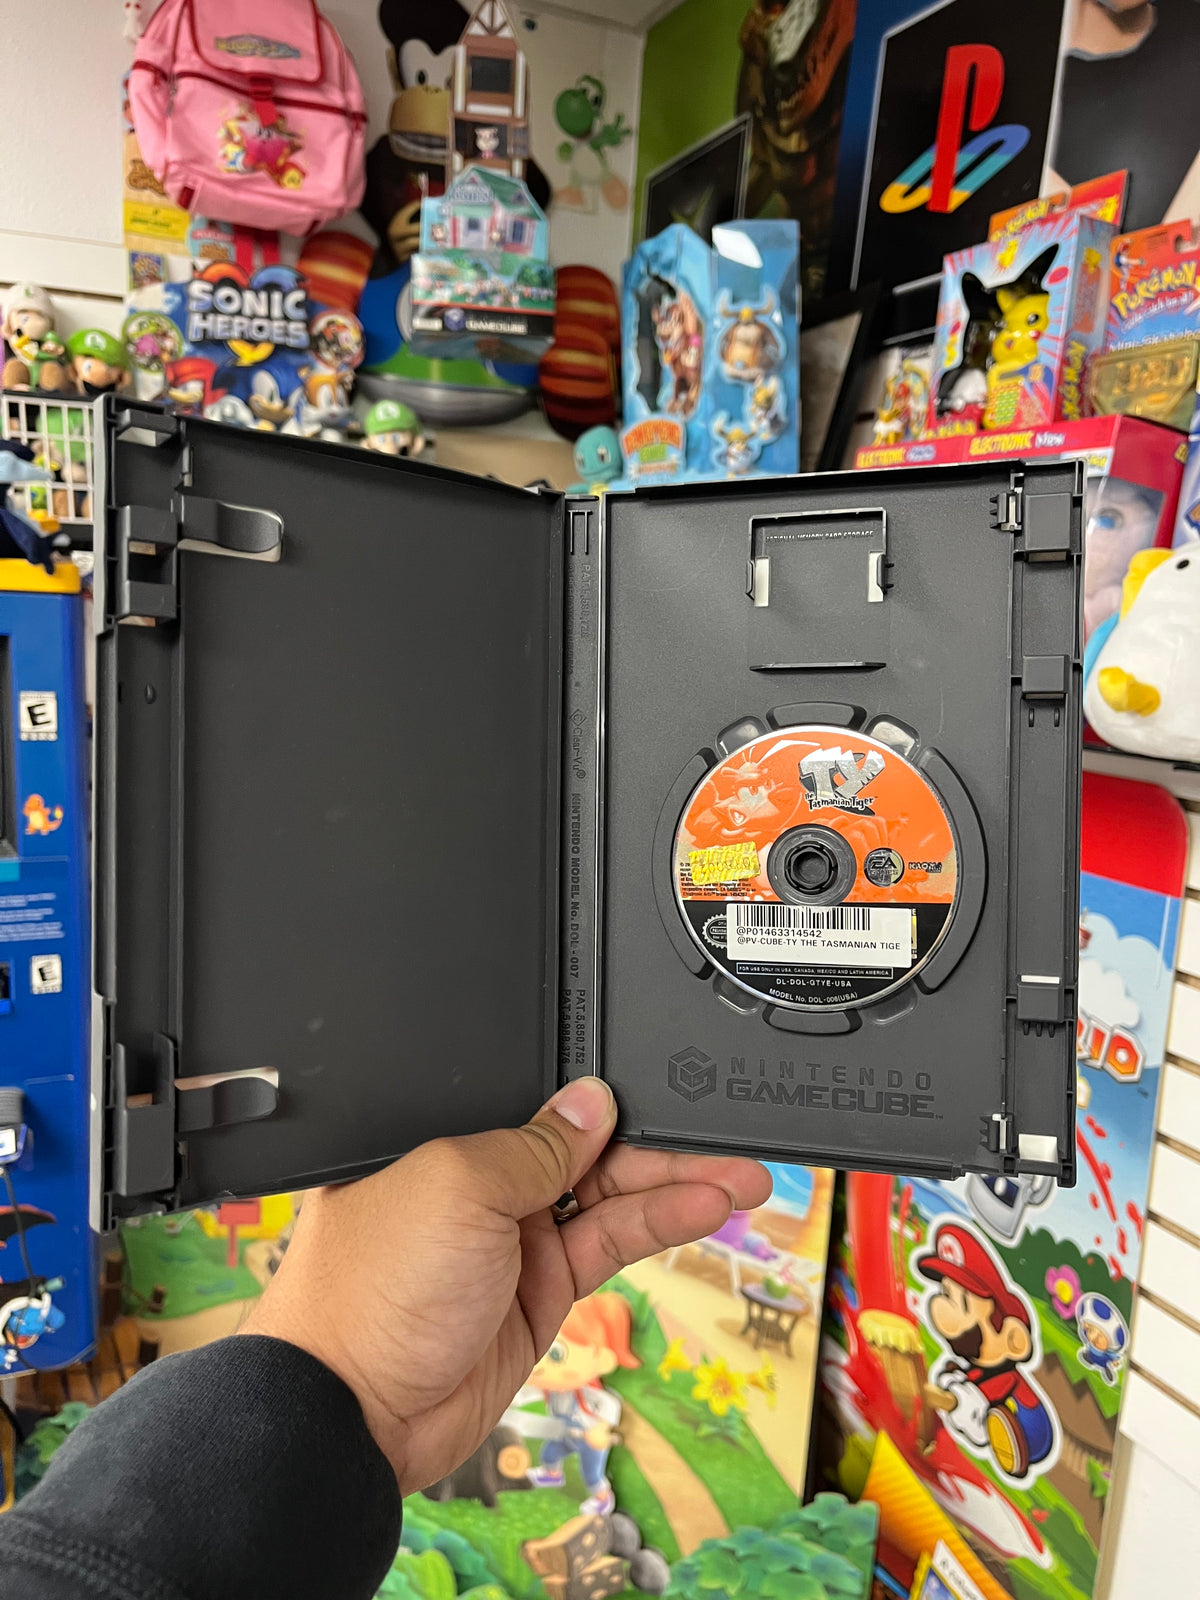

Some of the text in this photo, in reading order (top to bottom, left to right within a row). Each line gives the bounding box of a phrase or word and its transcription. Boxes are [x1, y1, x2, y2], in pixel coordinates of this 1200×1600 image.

[188, 279, 308, 321] SONIC
[188, 312, 310, 349] HEROES
[27, 703, 51, 727] E
[798, 746, 886, 801] TY
[571, 794, 581, 855] NINTENDO
[871, 856, 897, 869] EA
[570, 858, 581, 899] MODEL
[570, 902, 580, 921] No.
[736, 926, 822, 938] @P01463314542
[737, 936, 901, 950] @PV-CUBE-TY THE TASMANIAN TIGE
[769, 987, 794, 1002] MODEL
[730, 1056, 932, 1092] NINTENDO
